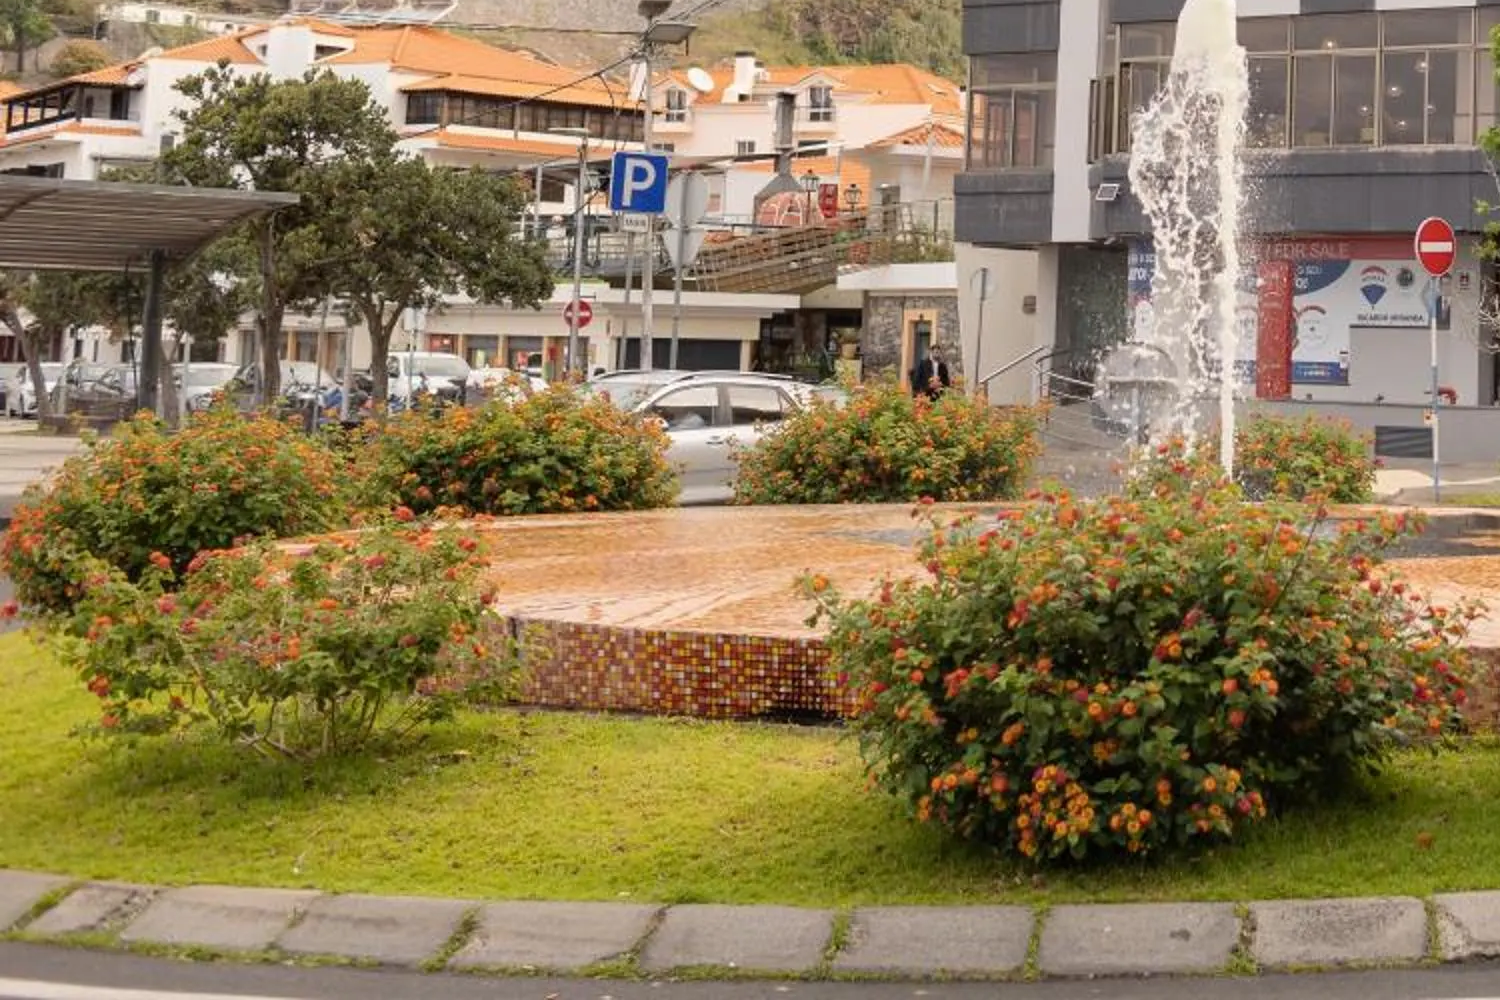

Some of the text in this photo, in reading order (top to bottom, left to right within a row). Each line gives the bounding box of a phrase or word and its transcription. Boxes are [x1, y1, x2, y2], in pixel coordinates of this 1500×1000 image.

[622, 158, 656, 207] P
[1276, 243, 1306, 259] FOR
[1309, 240, 1350, 258] SALE
